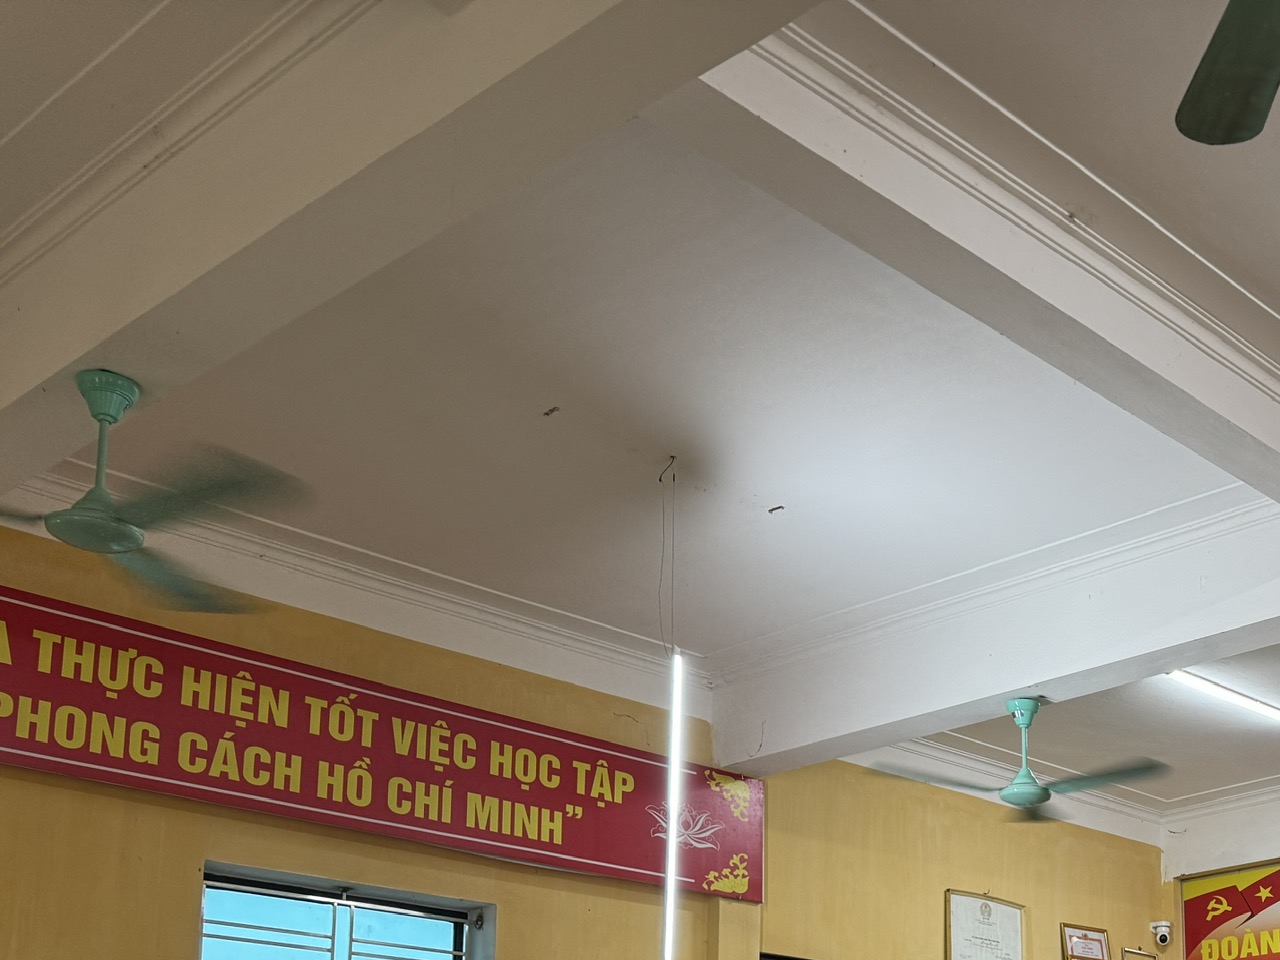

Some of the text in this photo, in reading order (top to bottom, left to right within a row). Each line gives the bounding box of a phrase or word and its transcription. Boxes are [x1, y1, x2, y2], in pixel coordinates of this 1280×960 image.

[33, 629, 164, 699] THỰC
[181, 666, 290, 728] HIỆN
[304, 693, 379, 749] TỐT
[392, 716, 477, 772] VIỆC
[490, 740, 561, 791] HỌC
[572, 759, 635, 808] TẬP
[178, 732, 302, 794] CÁCH
[316, 757, 373, 807] HỒ
[387, 776, 454, 824] CHÍ
